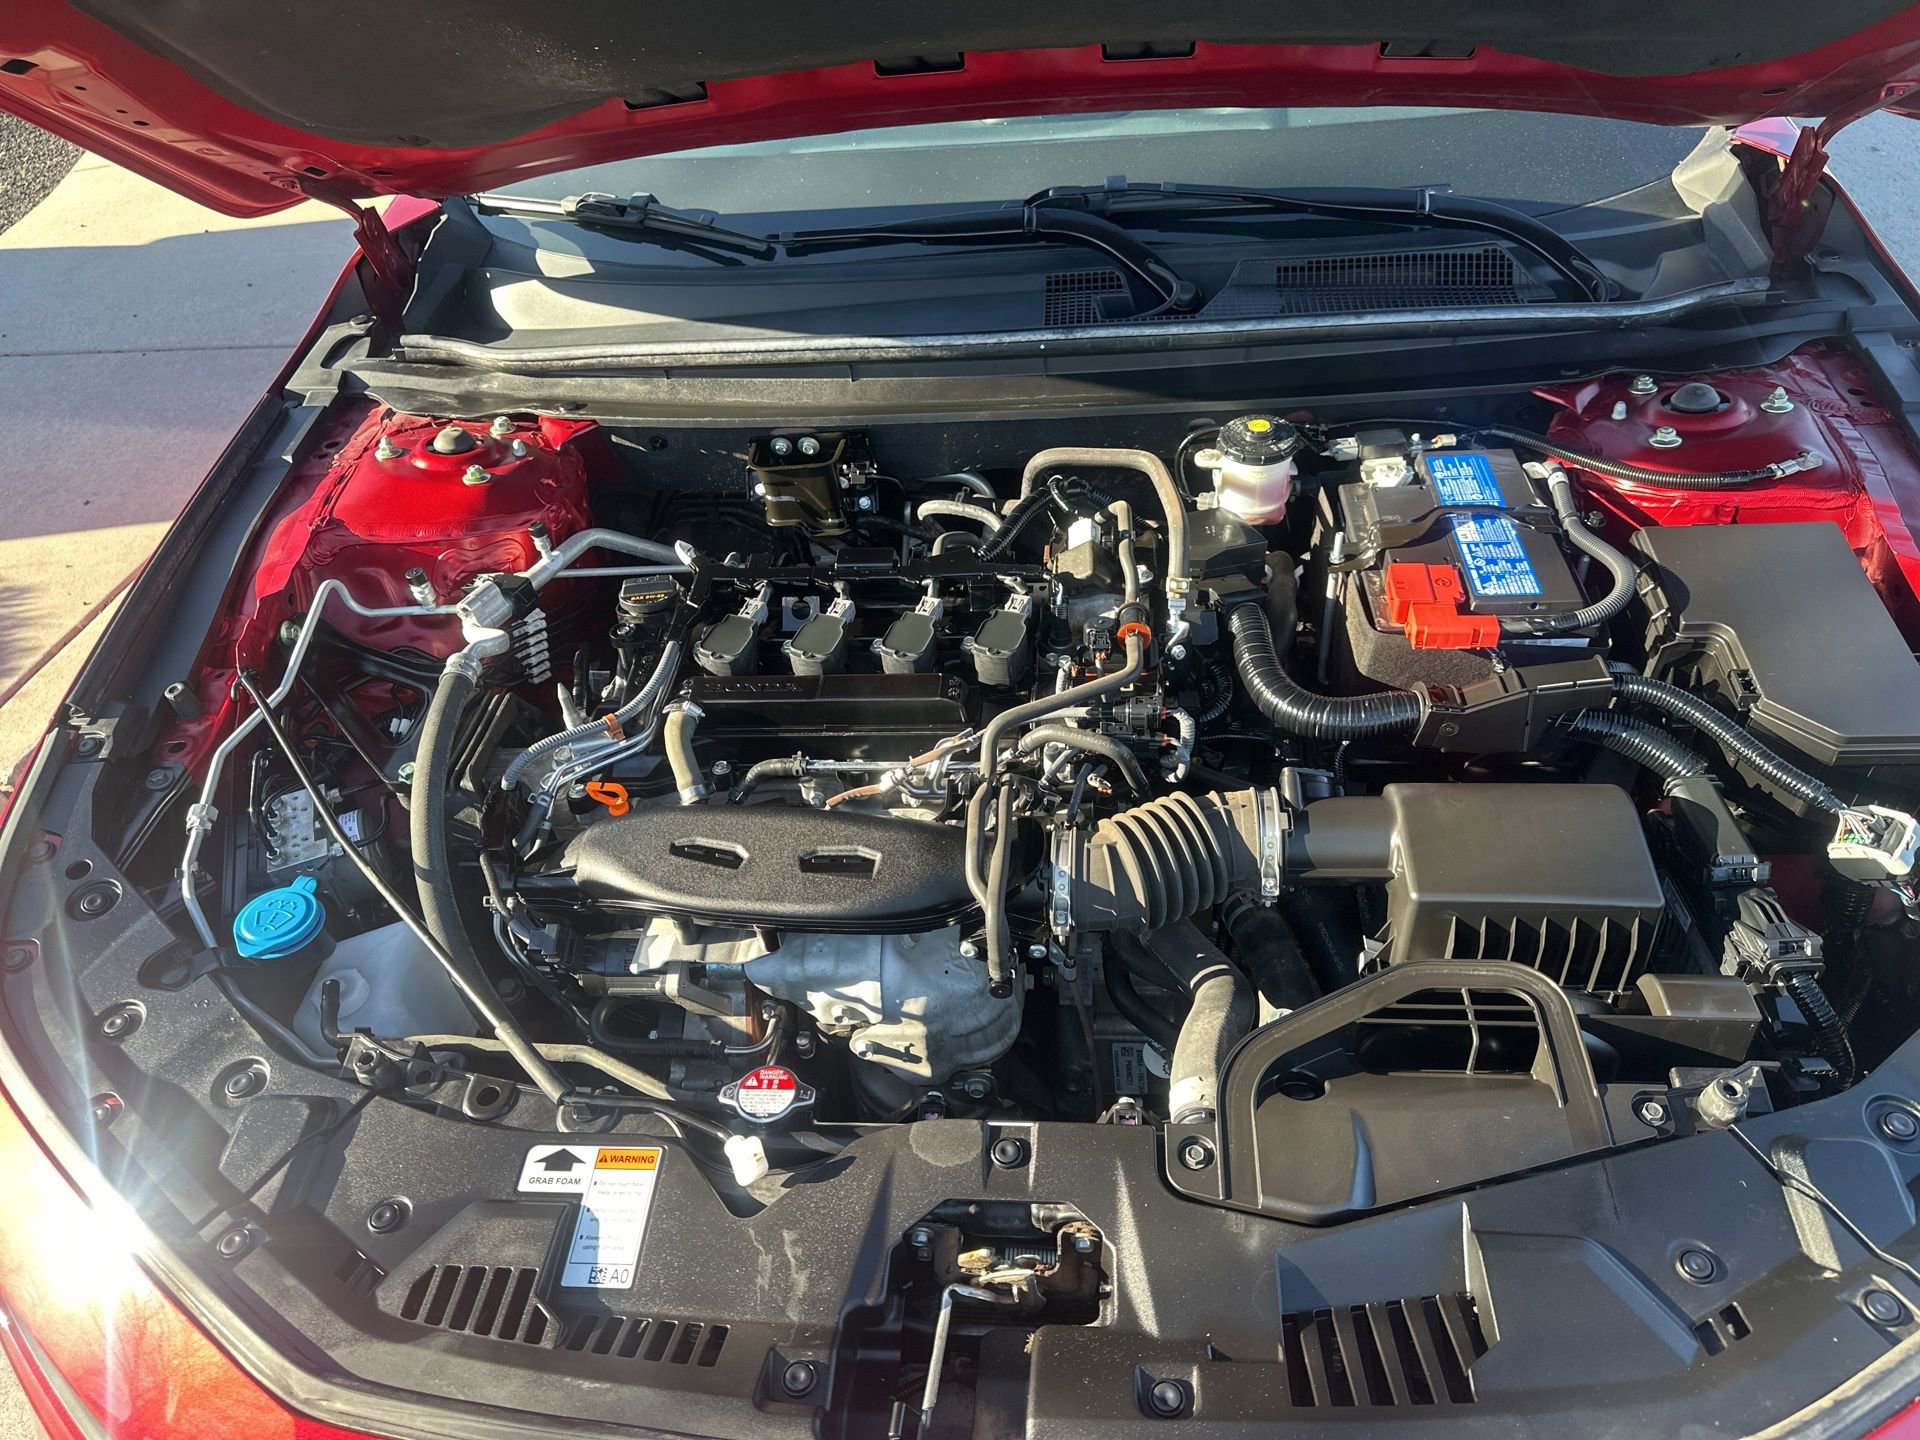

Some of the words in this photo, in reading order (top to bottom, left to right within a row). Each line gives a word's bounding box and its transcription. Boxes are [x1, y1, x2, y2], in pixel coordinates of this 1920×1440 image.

[609, 1155, 655, 1164] WARNING
[528, 1177, 554, 1185] GRAB
[555, 1177, 582, 1186] FOAM
[609, 1268, 630, 1284] A0
